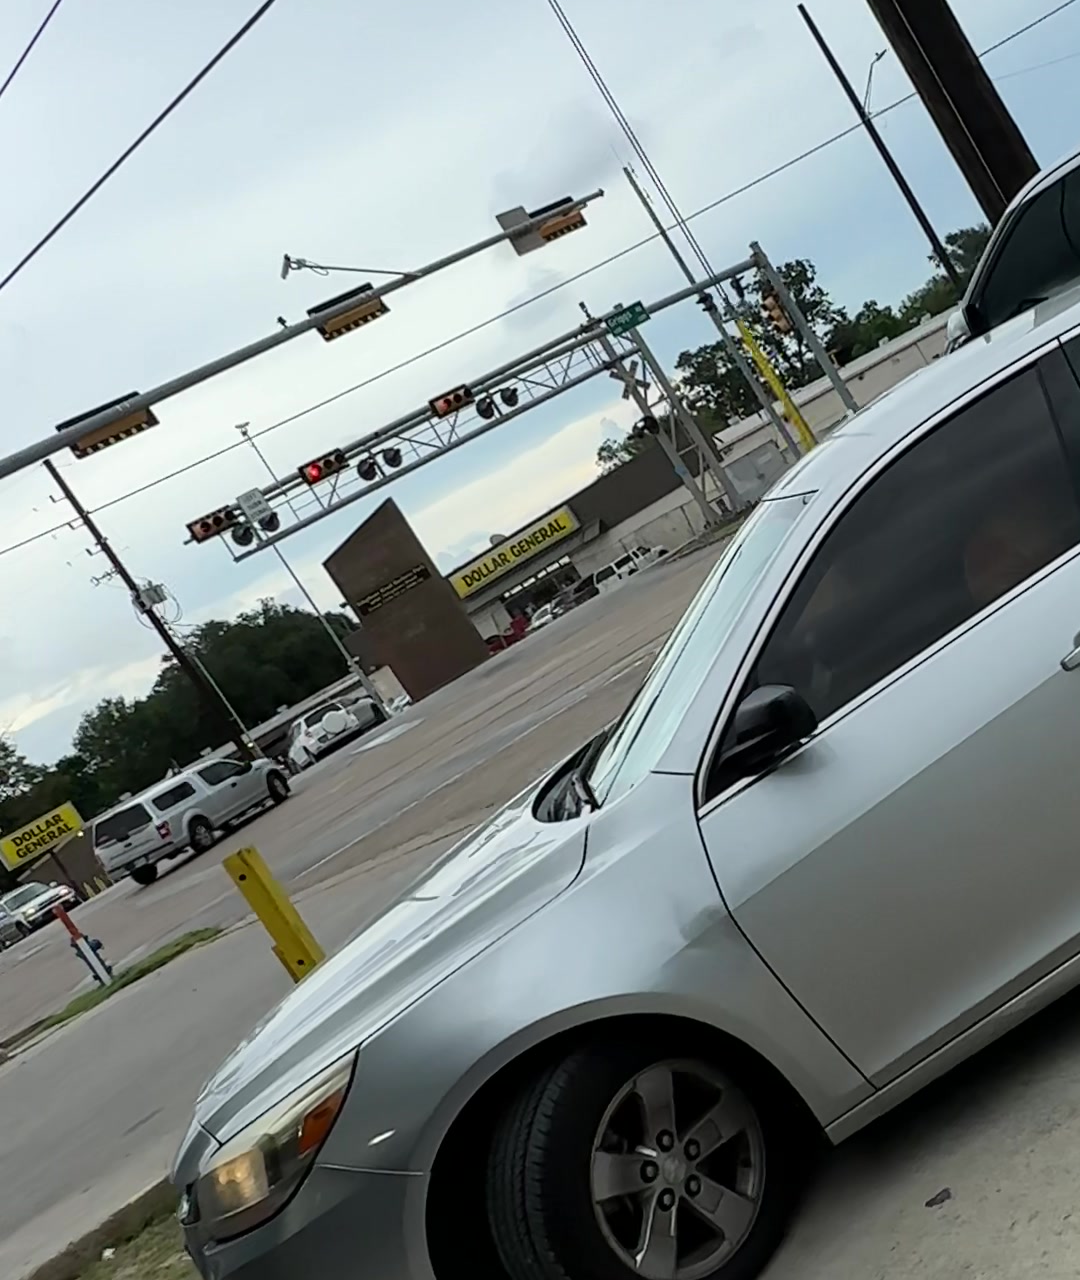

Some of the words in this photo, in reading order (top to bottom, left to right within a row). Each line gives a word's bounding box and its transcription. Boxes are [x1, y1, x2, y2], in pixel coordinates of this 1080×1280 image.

[607, 311, 632, 327] Griggs
[461, 551, 510, 588] DOLLAR
[510, 518, 567, 558] GENERAL
[11, 813, 64, 847] DOLLAR
[16, 823, 74, 859] GENERAL
